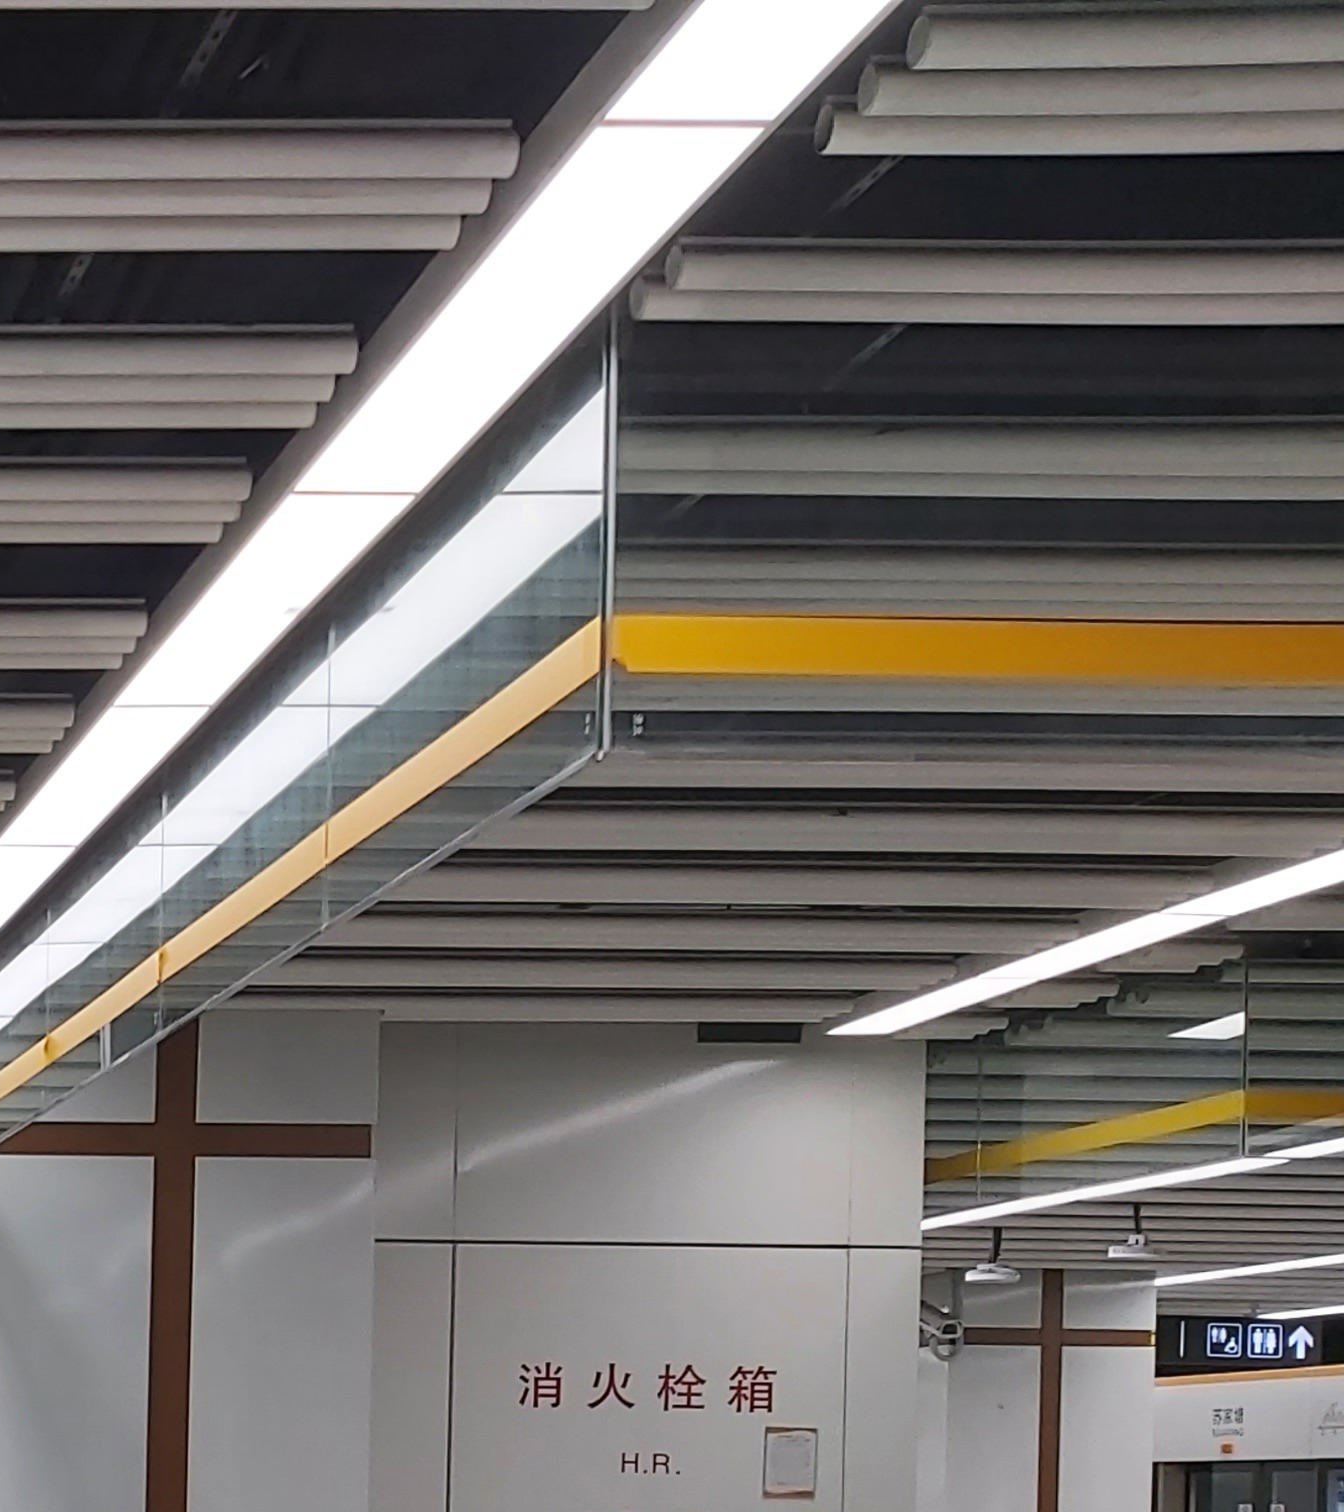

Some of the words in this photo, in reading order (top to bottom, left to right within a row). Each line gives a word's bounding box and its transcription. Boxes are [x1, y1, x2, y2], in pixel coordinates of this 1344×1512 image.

[518, 1361, 778, 1413] 消火栓箱
[620, 1452, 682, 1476] H.R.
